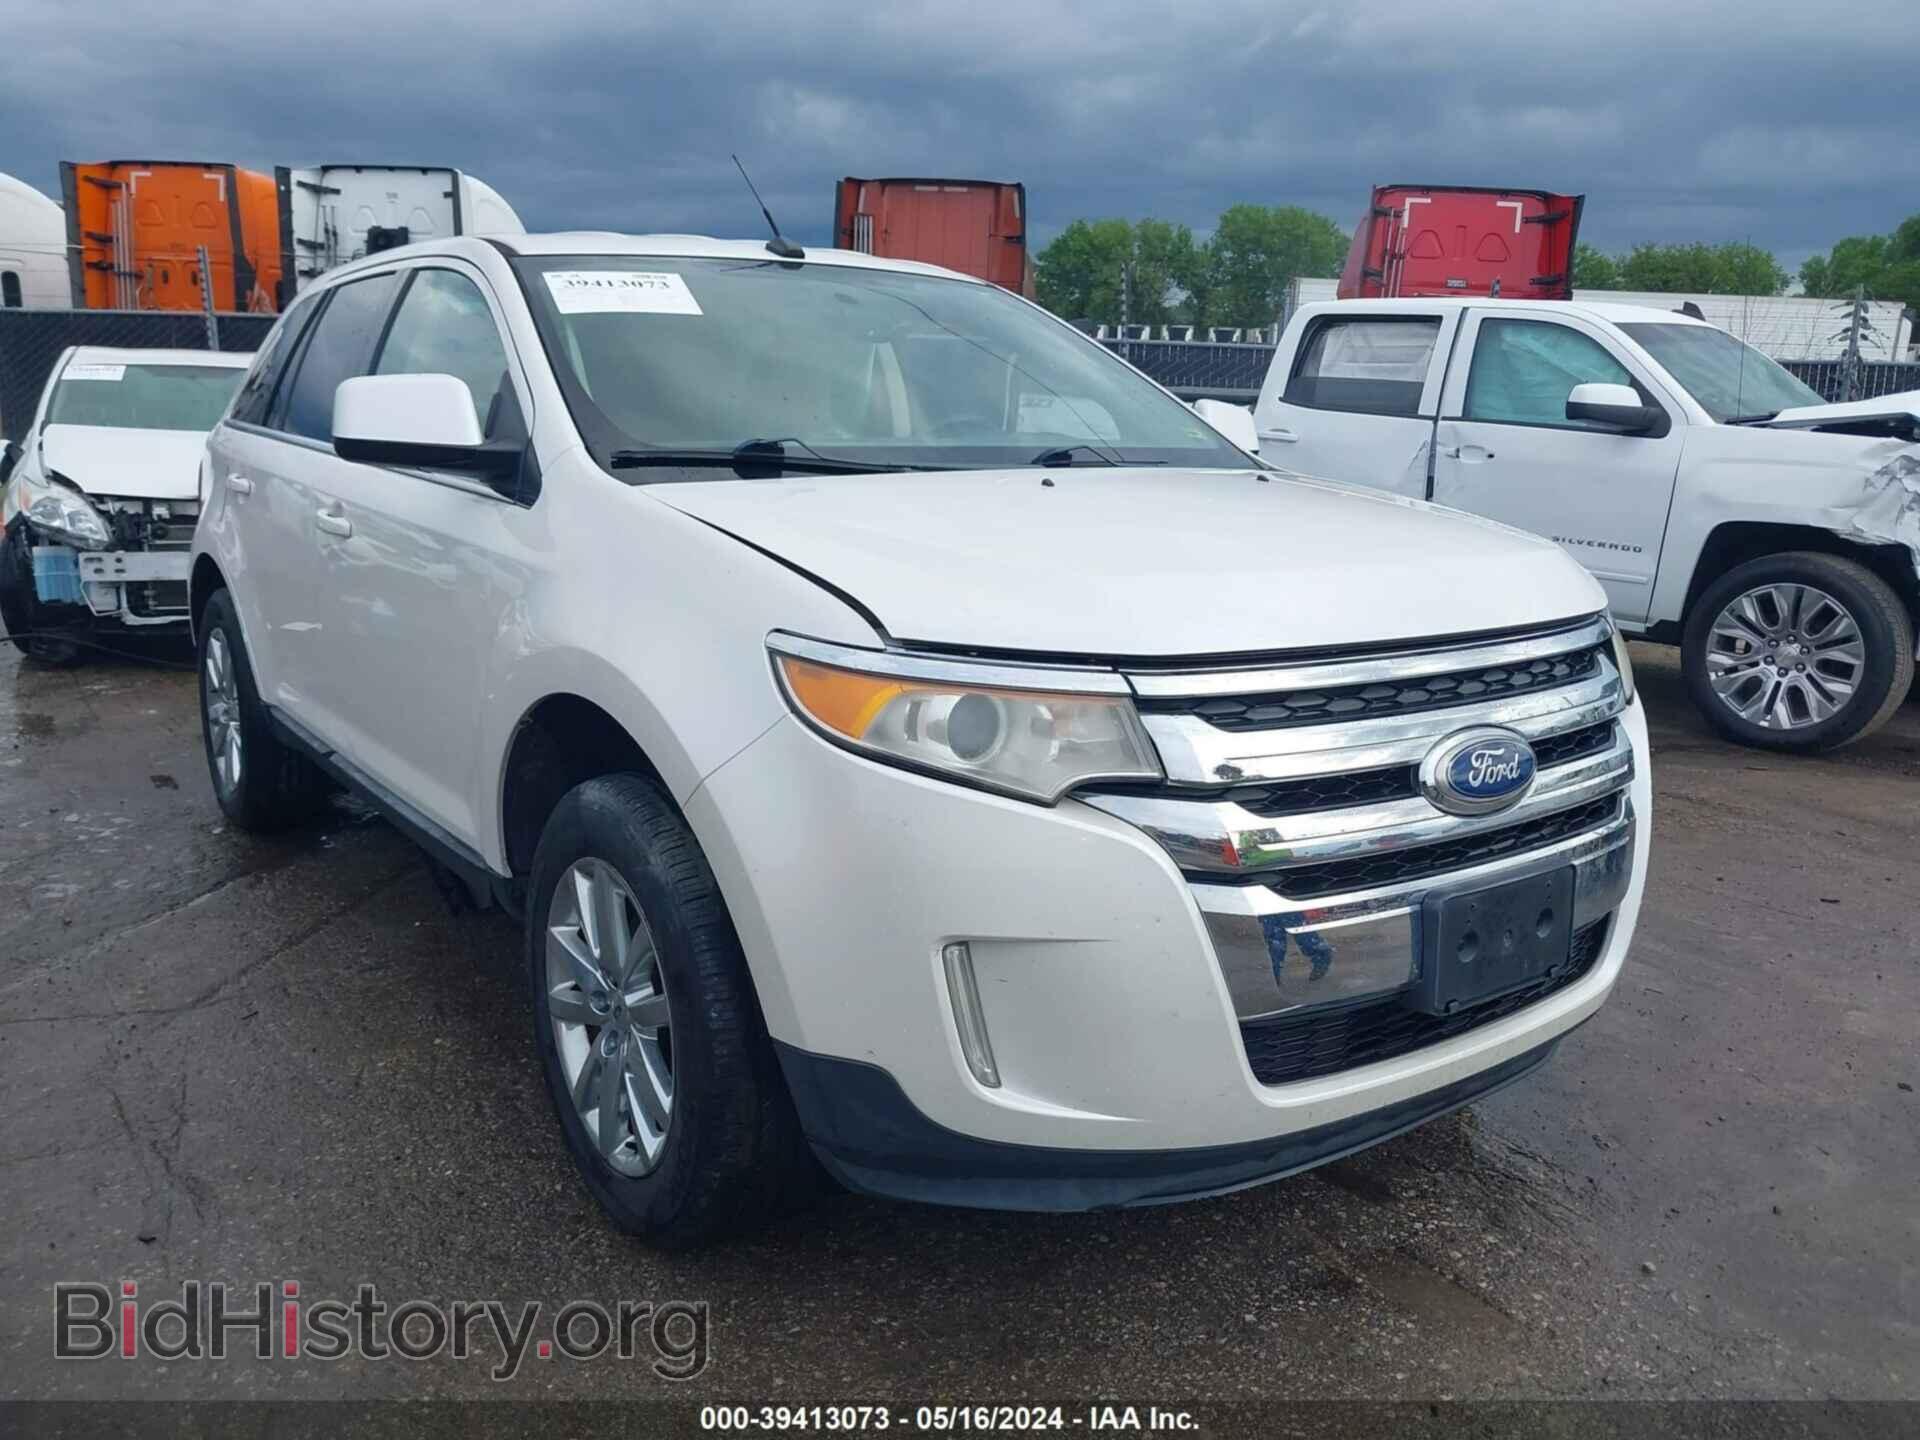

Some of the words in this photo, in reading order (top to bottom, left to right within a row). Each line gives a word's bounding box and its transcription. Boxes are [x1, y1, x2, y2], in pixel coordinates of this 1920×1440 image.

[564, 278, 671, 289] 39413073
[1551, 535, 1643, 554] SILVERADO
[1468, 748, 1521, 788] Ford
